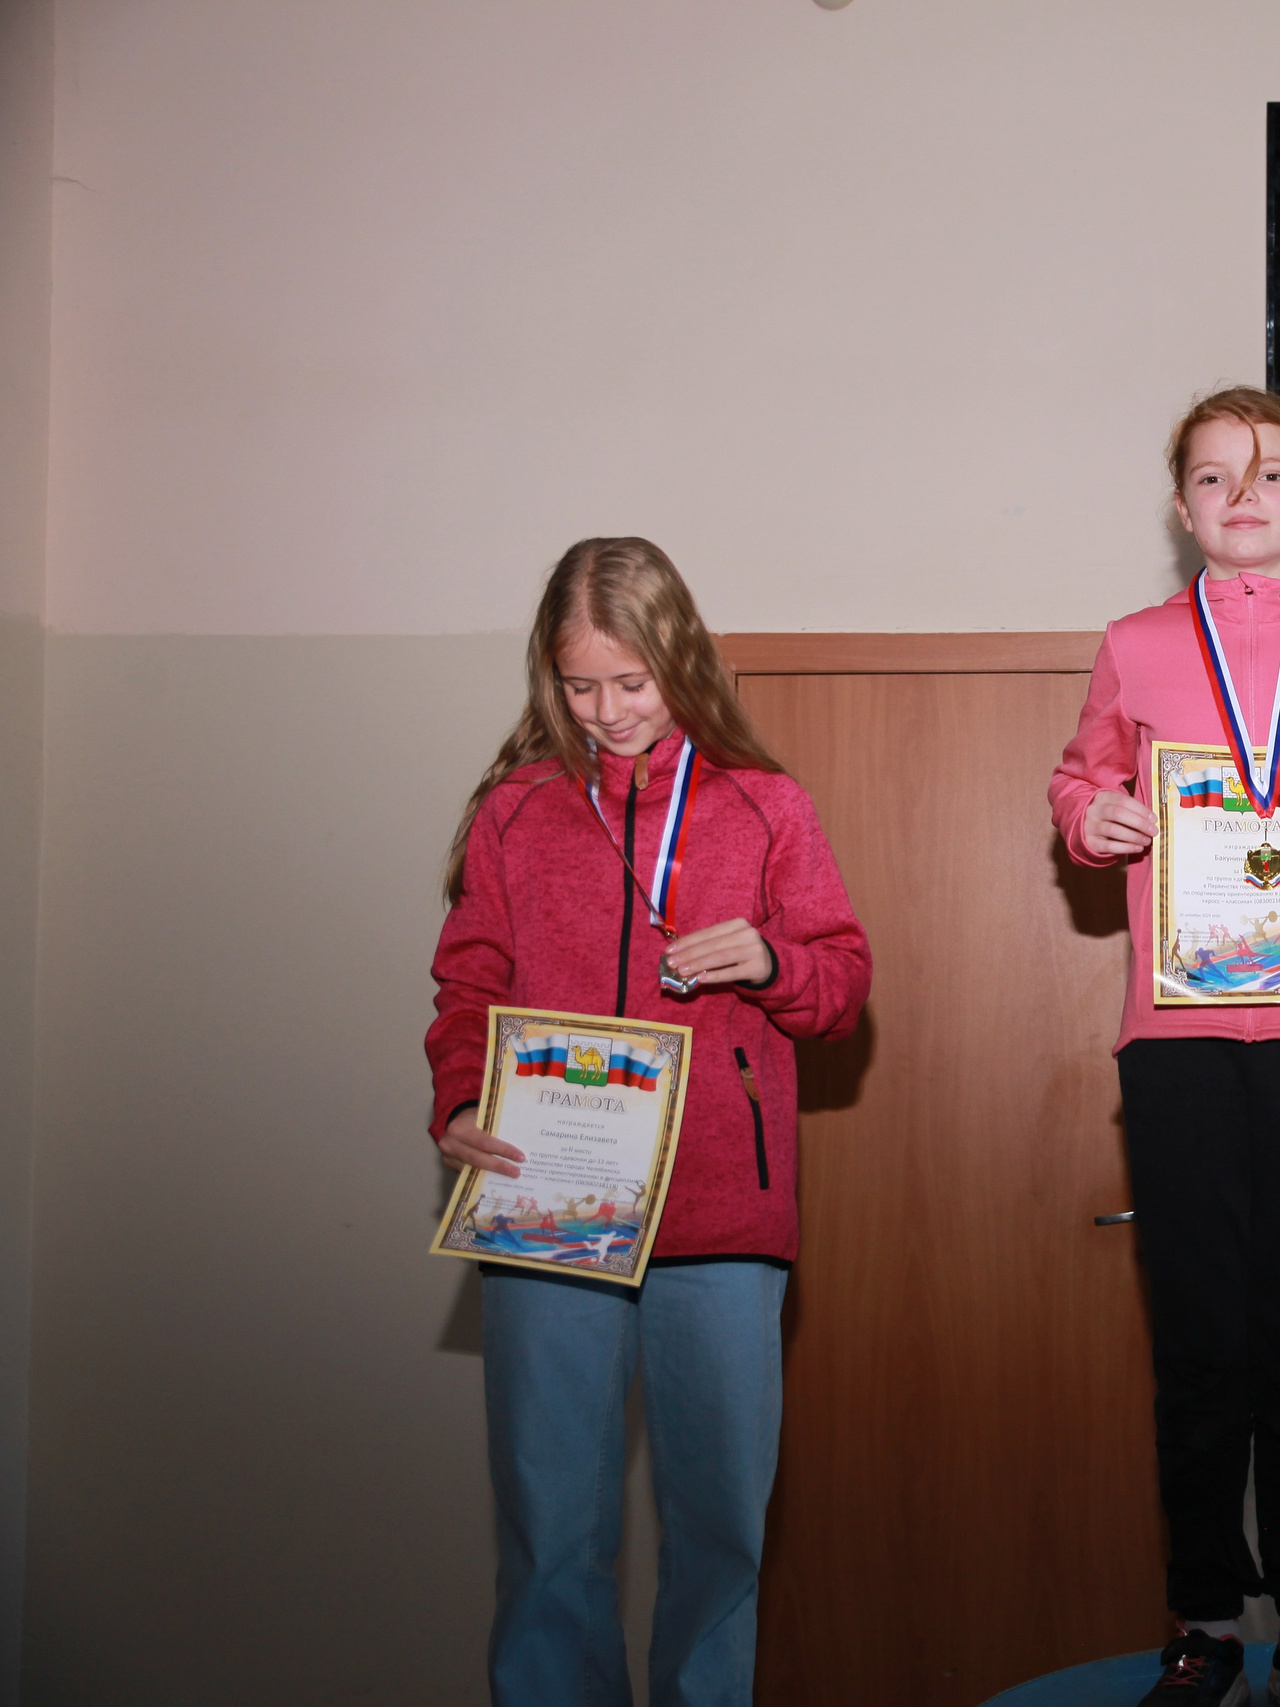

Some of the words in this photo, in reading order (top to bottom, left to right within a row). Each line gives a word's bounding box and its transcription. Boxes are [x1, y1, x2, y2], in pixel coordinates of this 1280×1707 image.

[539, 1090, 626, 1112] ГРАМОТА
[558, 1120, 605, 1129] награждается
[540, 1129, 578, 1140] Самарина
[580, 1134, 618, 1144] Елизавета
[538, 1152, 558, 1160] группе
[529, 1159, 563, 1168] Первенстве
[586, 1165, 620, 1174] Челябинска
